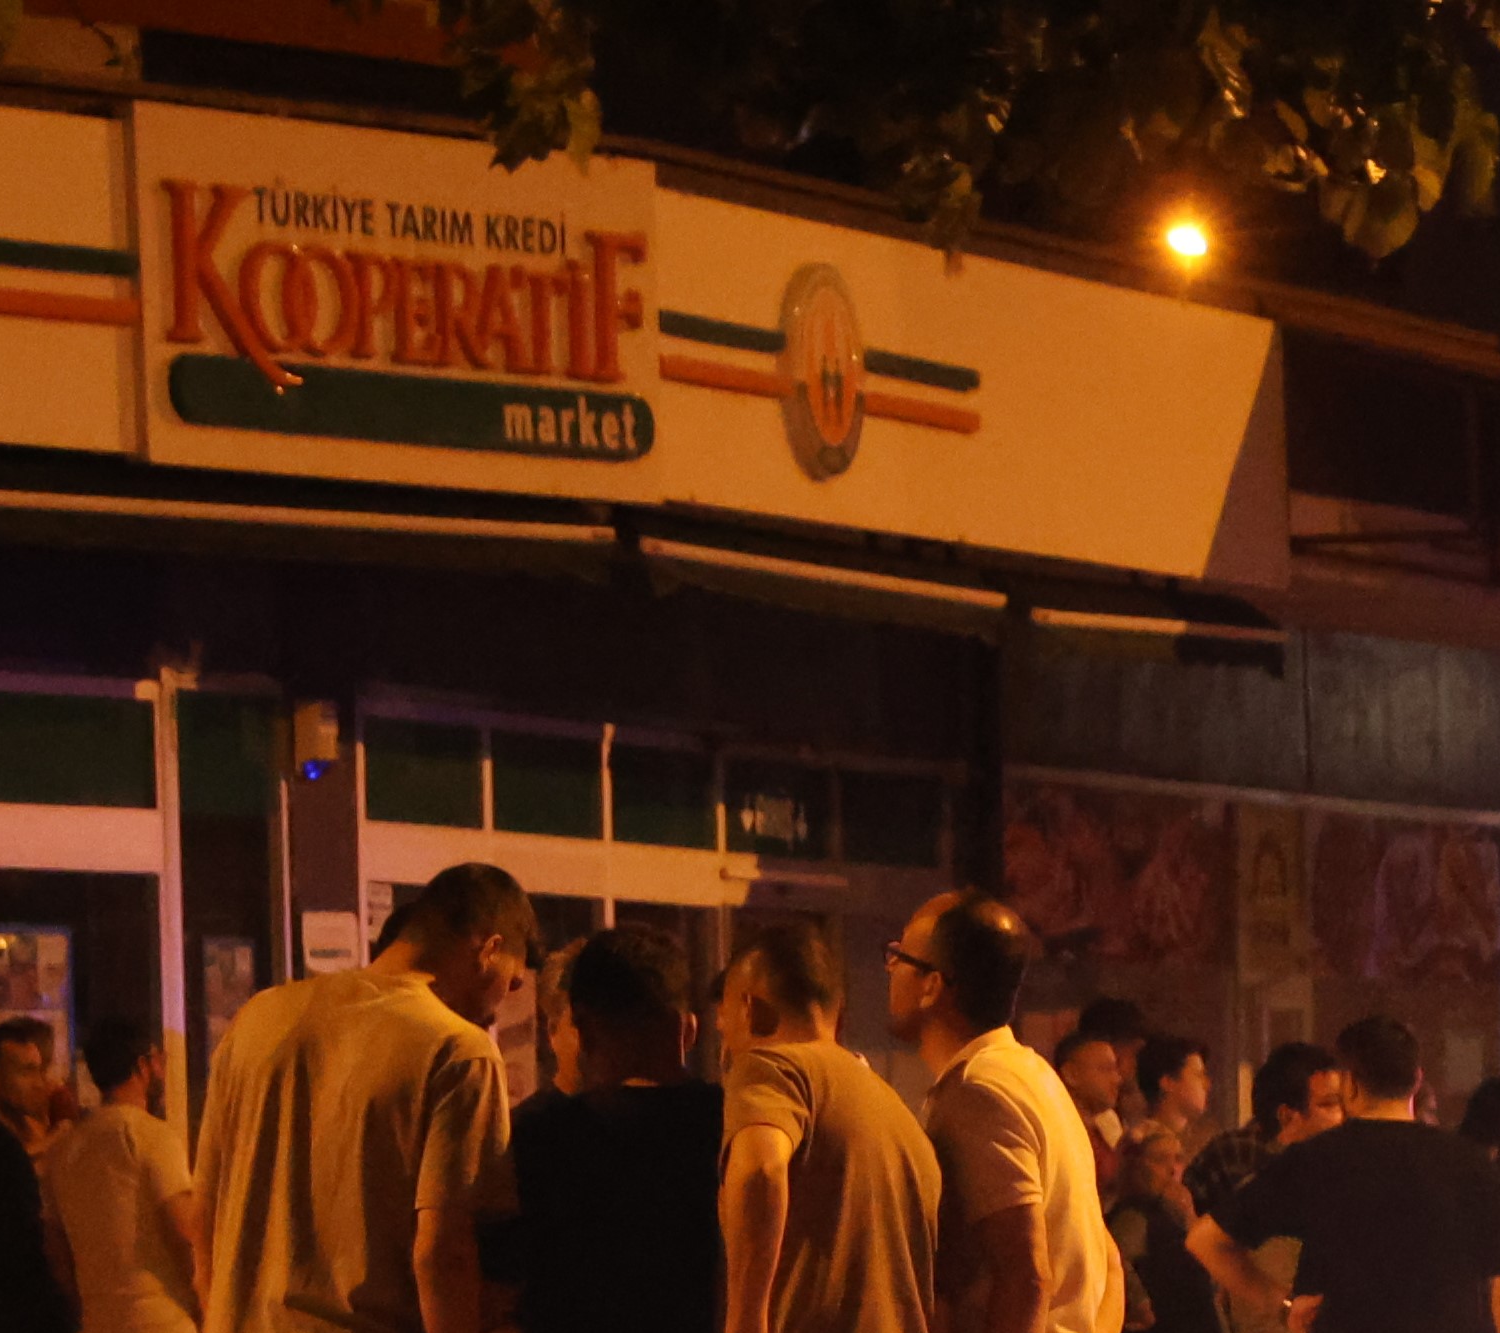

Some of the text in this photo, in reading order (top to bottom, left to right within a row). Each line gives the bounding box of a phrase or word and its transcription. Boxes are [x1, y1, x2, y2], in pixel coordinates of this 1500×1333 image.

[253, 178, 567, 256] TÜRKİYE TARIM KREDİ
[503, 395, 637, 452] market
